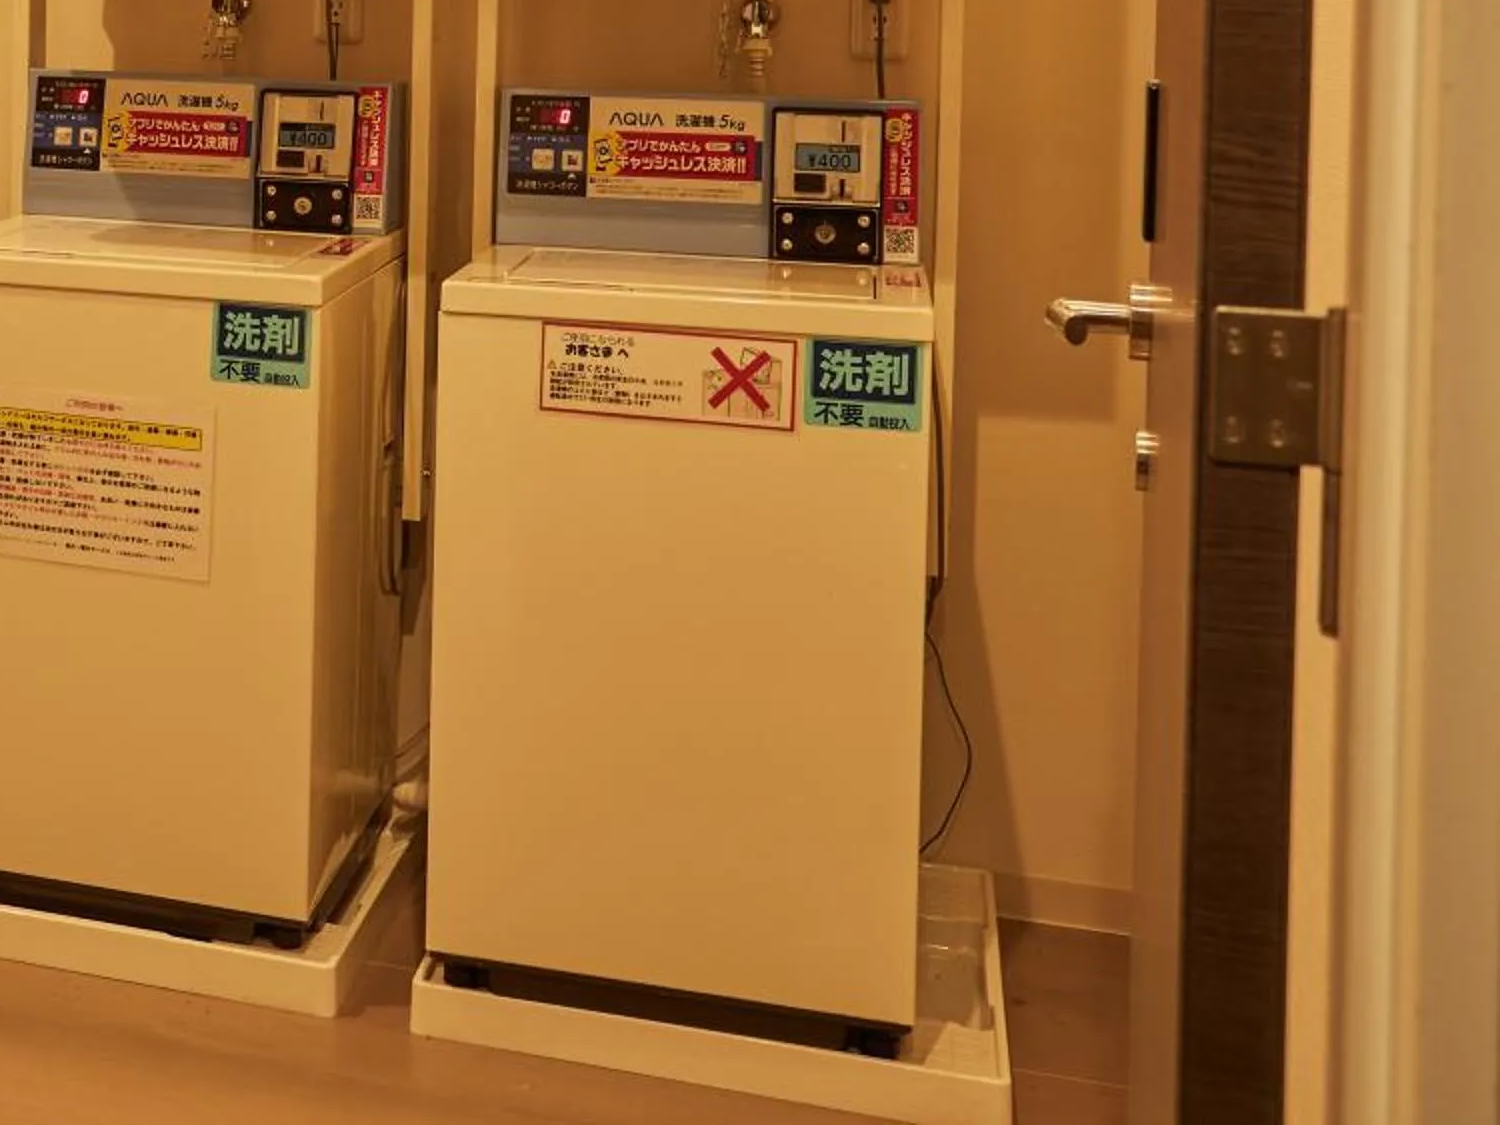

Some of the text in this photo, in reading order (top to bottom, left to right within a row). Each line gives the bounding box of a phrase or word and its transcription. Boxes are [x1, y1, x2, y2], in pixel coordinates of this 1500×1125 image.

[79, 90, 89, 104] 0
[121, 92, 168, 107] AQUA
[560, 109, 571, 124] 0
[608, 112, 664, 127] AQUA
[617, 138, 701, 153] アプリでかんたん
[807, 154, 851, 169] ¥400
[223, 311, 300, 355] 洗剤
[219, 359, 260, 384] 不要
[819, 348, 910, 396] 洗剤
[814, 401, 911, 430] 不要 自動投入
